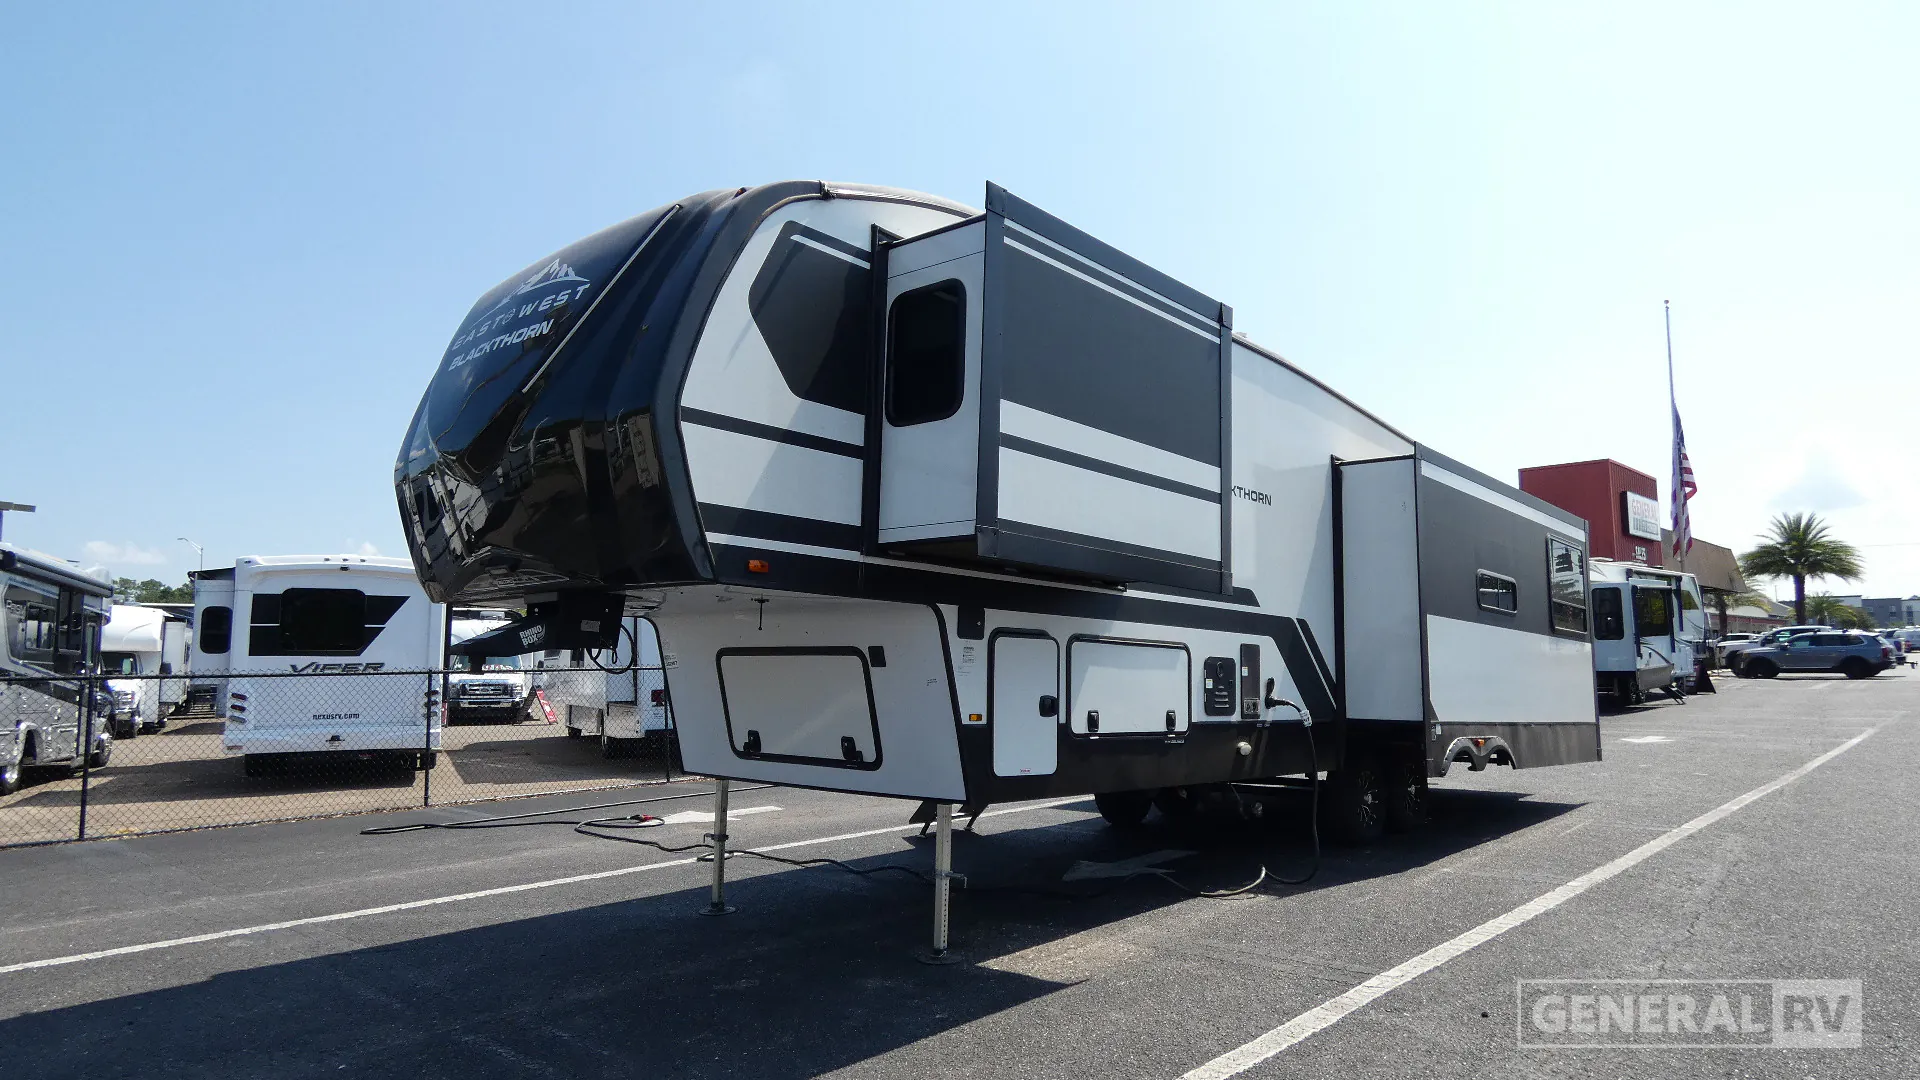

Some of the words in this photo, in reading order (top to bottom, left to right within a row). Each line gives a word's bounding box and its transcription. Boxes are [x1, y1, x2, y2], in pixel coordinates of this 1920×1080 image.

[452, 313, 505, 351] EAST
[518, 283, 591, 318] WEST
[448, 318, 555, 371] BLACKTHORN
[520, 625, 543, 639] RHINO
[521, 634, 539, 646] BOX
[290, 661, 385, 673] VIPER
